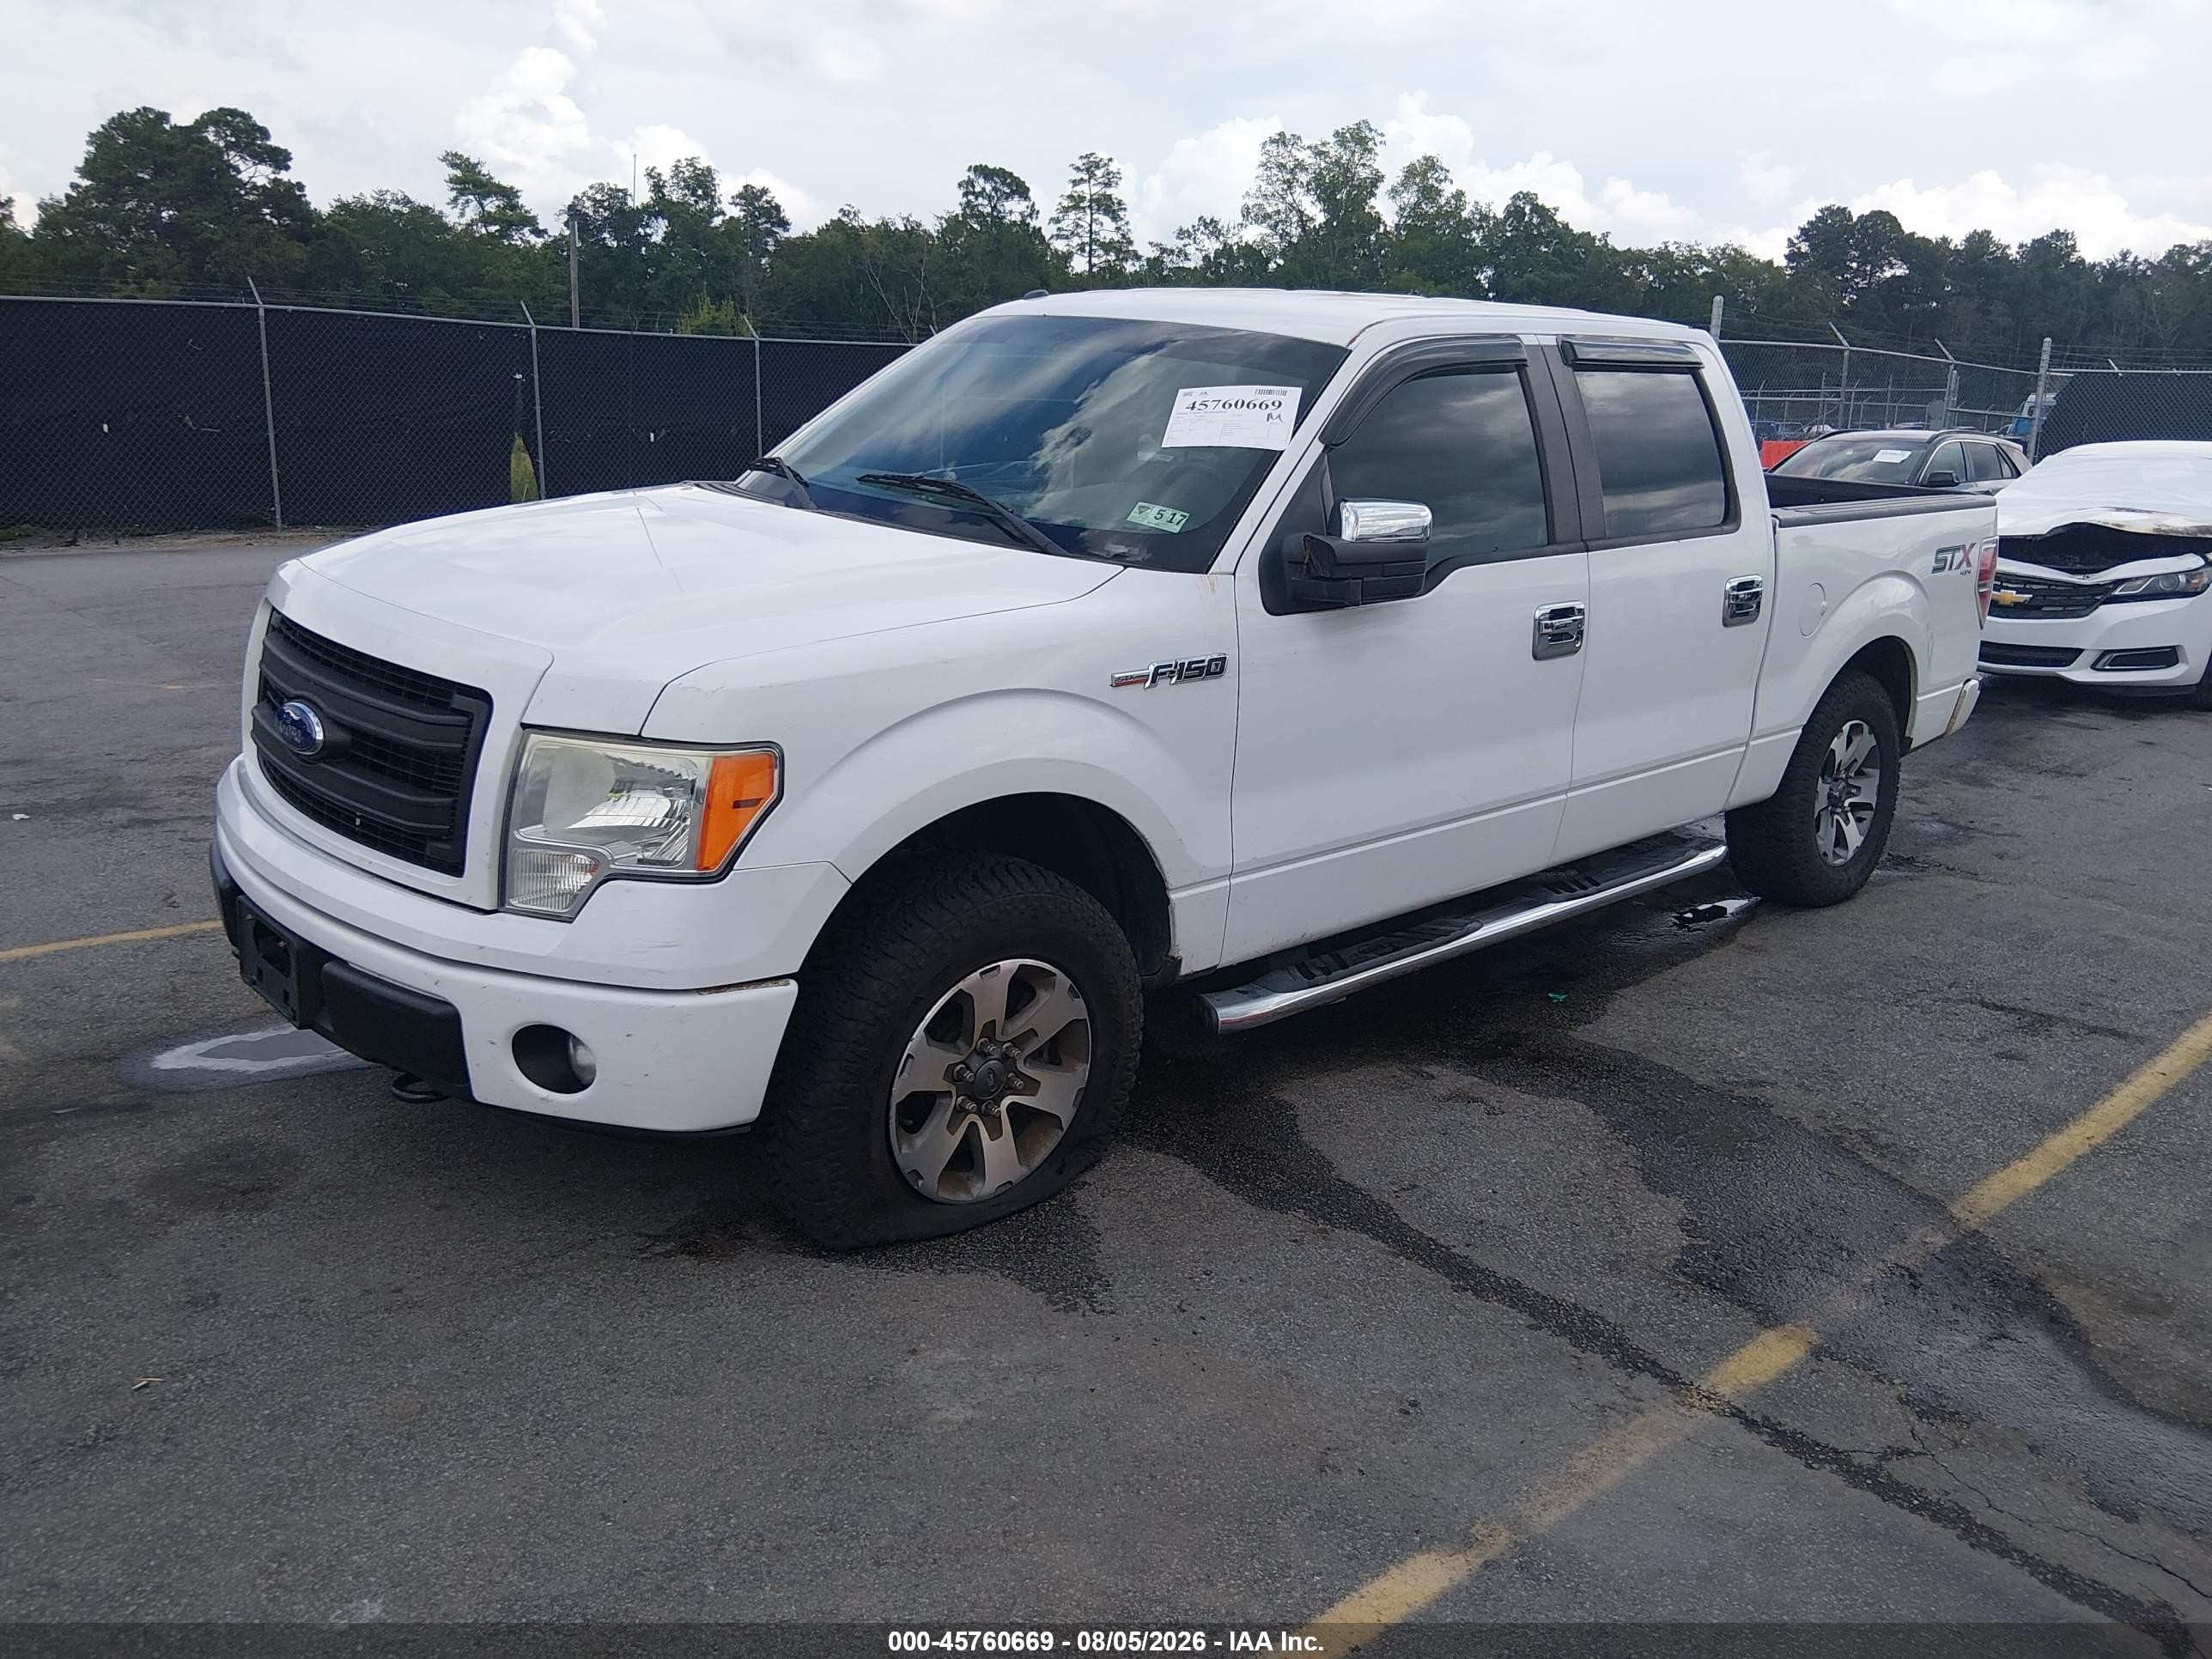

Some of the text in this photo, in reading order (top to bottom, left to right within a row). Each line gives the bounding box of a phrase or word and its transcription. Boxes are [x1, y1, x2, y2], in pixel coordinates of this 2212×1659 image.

[1185, 398, 1283, 410] 45760669
[1154, 509, 1188, 526] 5 17
[1931, 543, 1977, 574] STX
[1144, 653, 1229, 690] F-150
